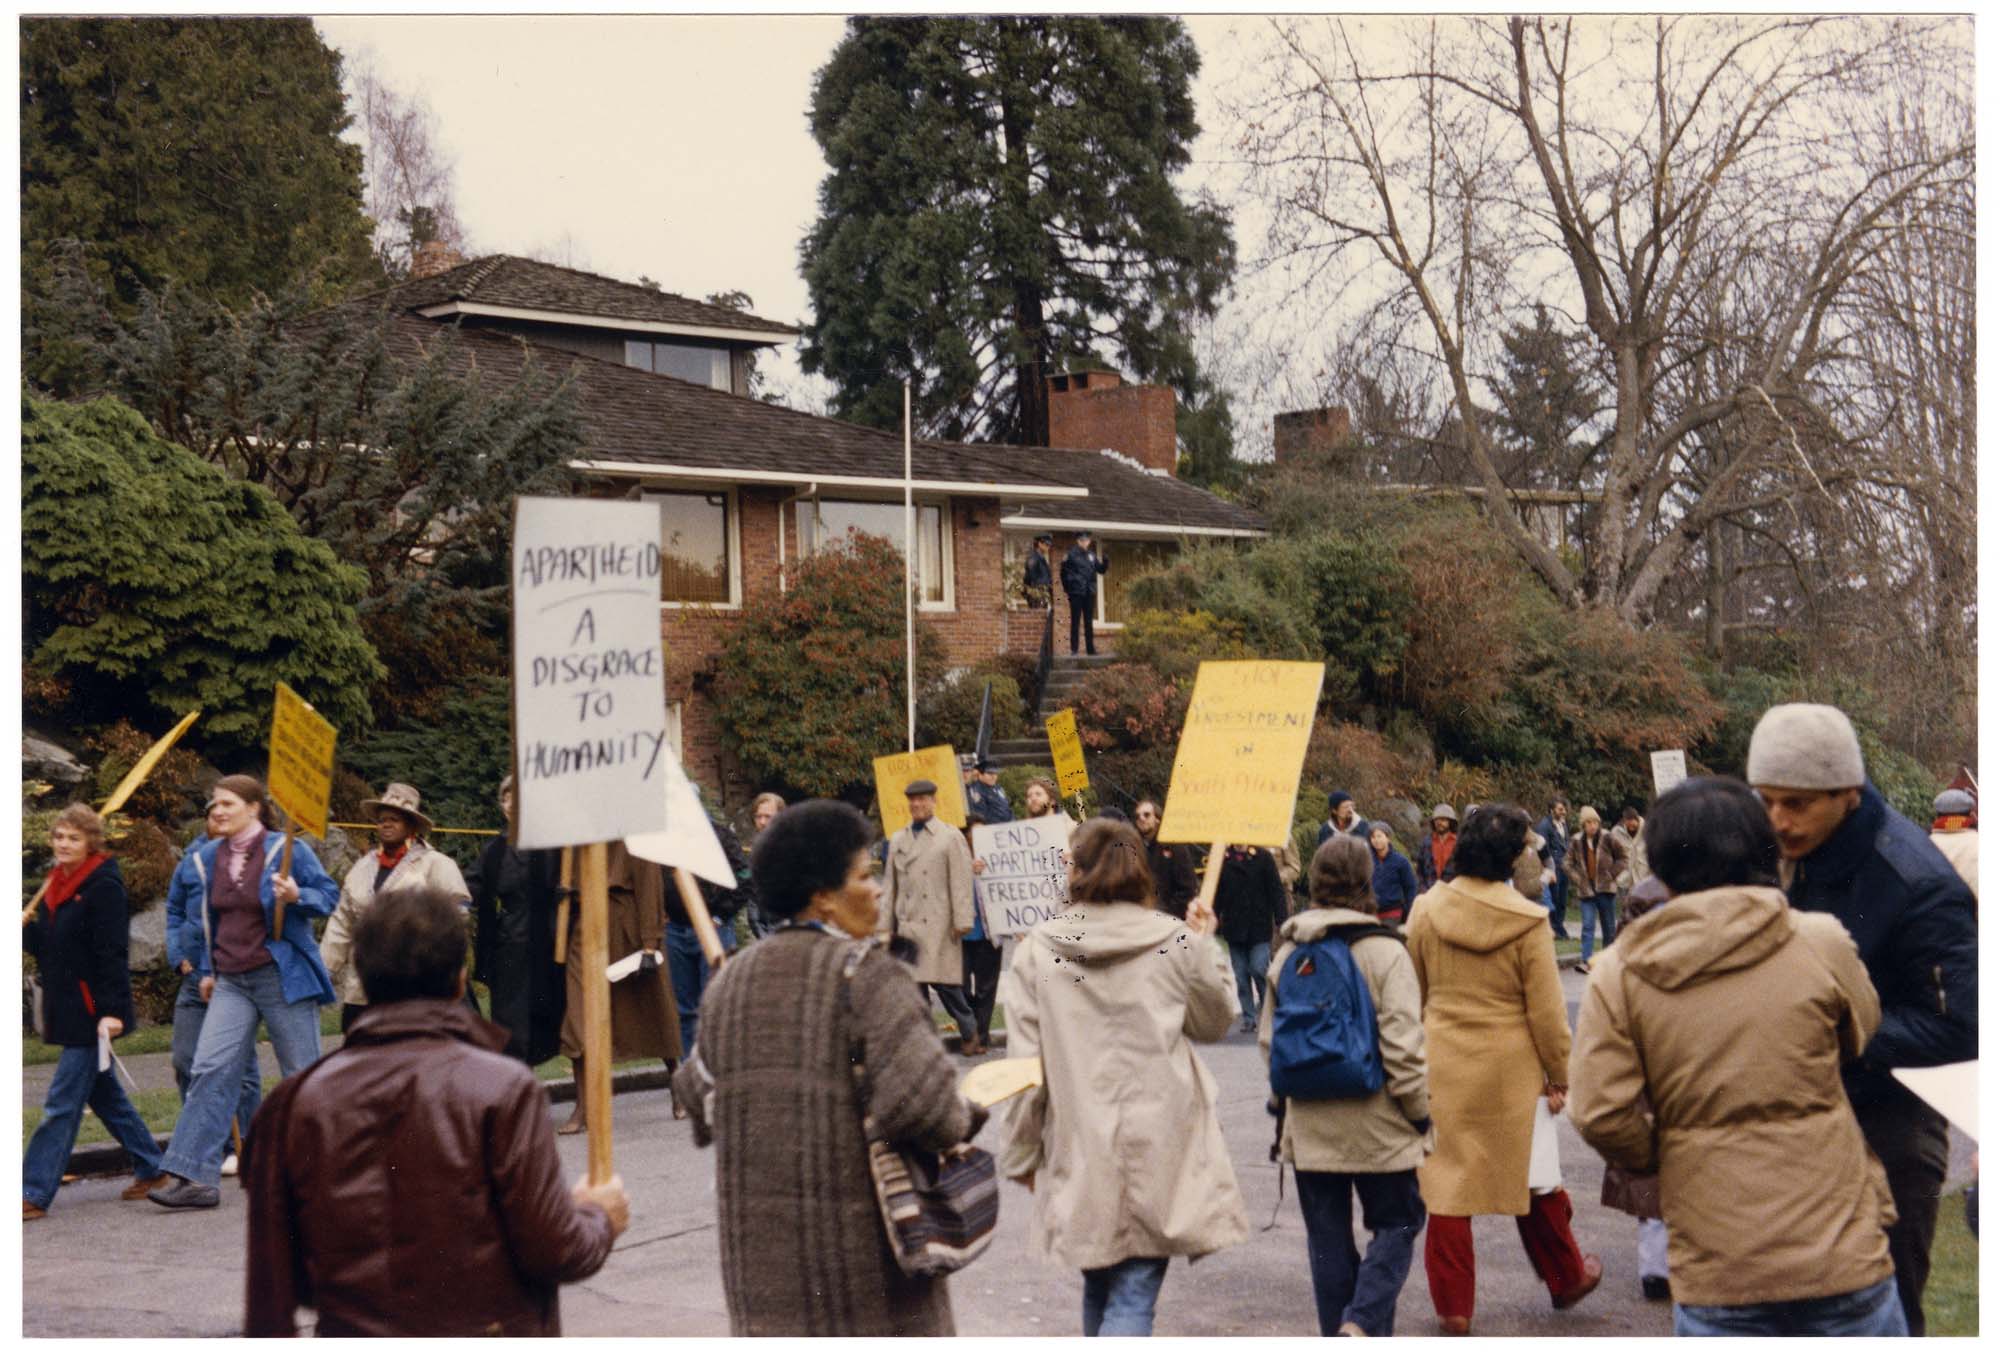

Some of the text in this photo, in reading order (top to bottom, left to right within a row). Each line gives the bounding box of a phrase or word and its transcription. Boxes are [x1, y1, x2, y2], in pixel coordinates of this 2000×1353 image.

[570, 607, 596, 647] A
[532, 648, 658, 688] DISGRACE
[575, 691, 613, 722] TO
[994, 826, 1040, 849] END
[1006, 905, 1054, 928] NOW
